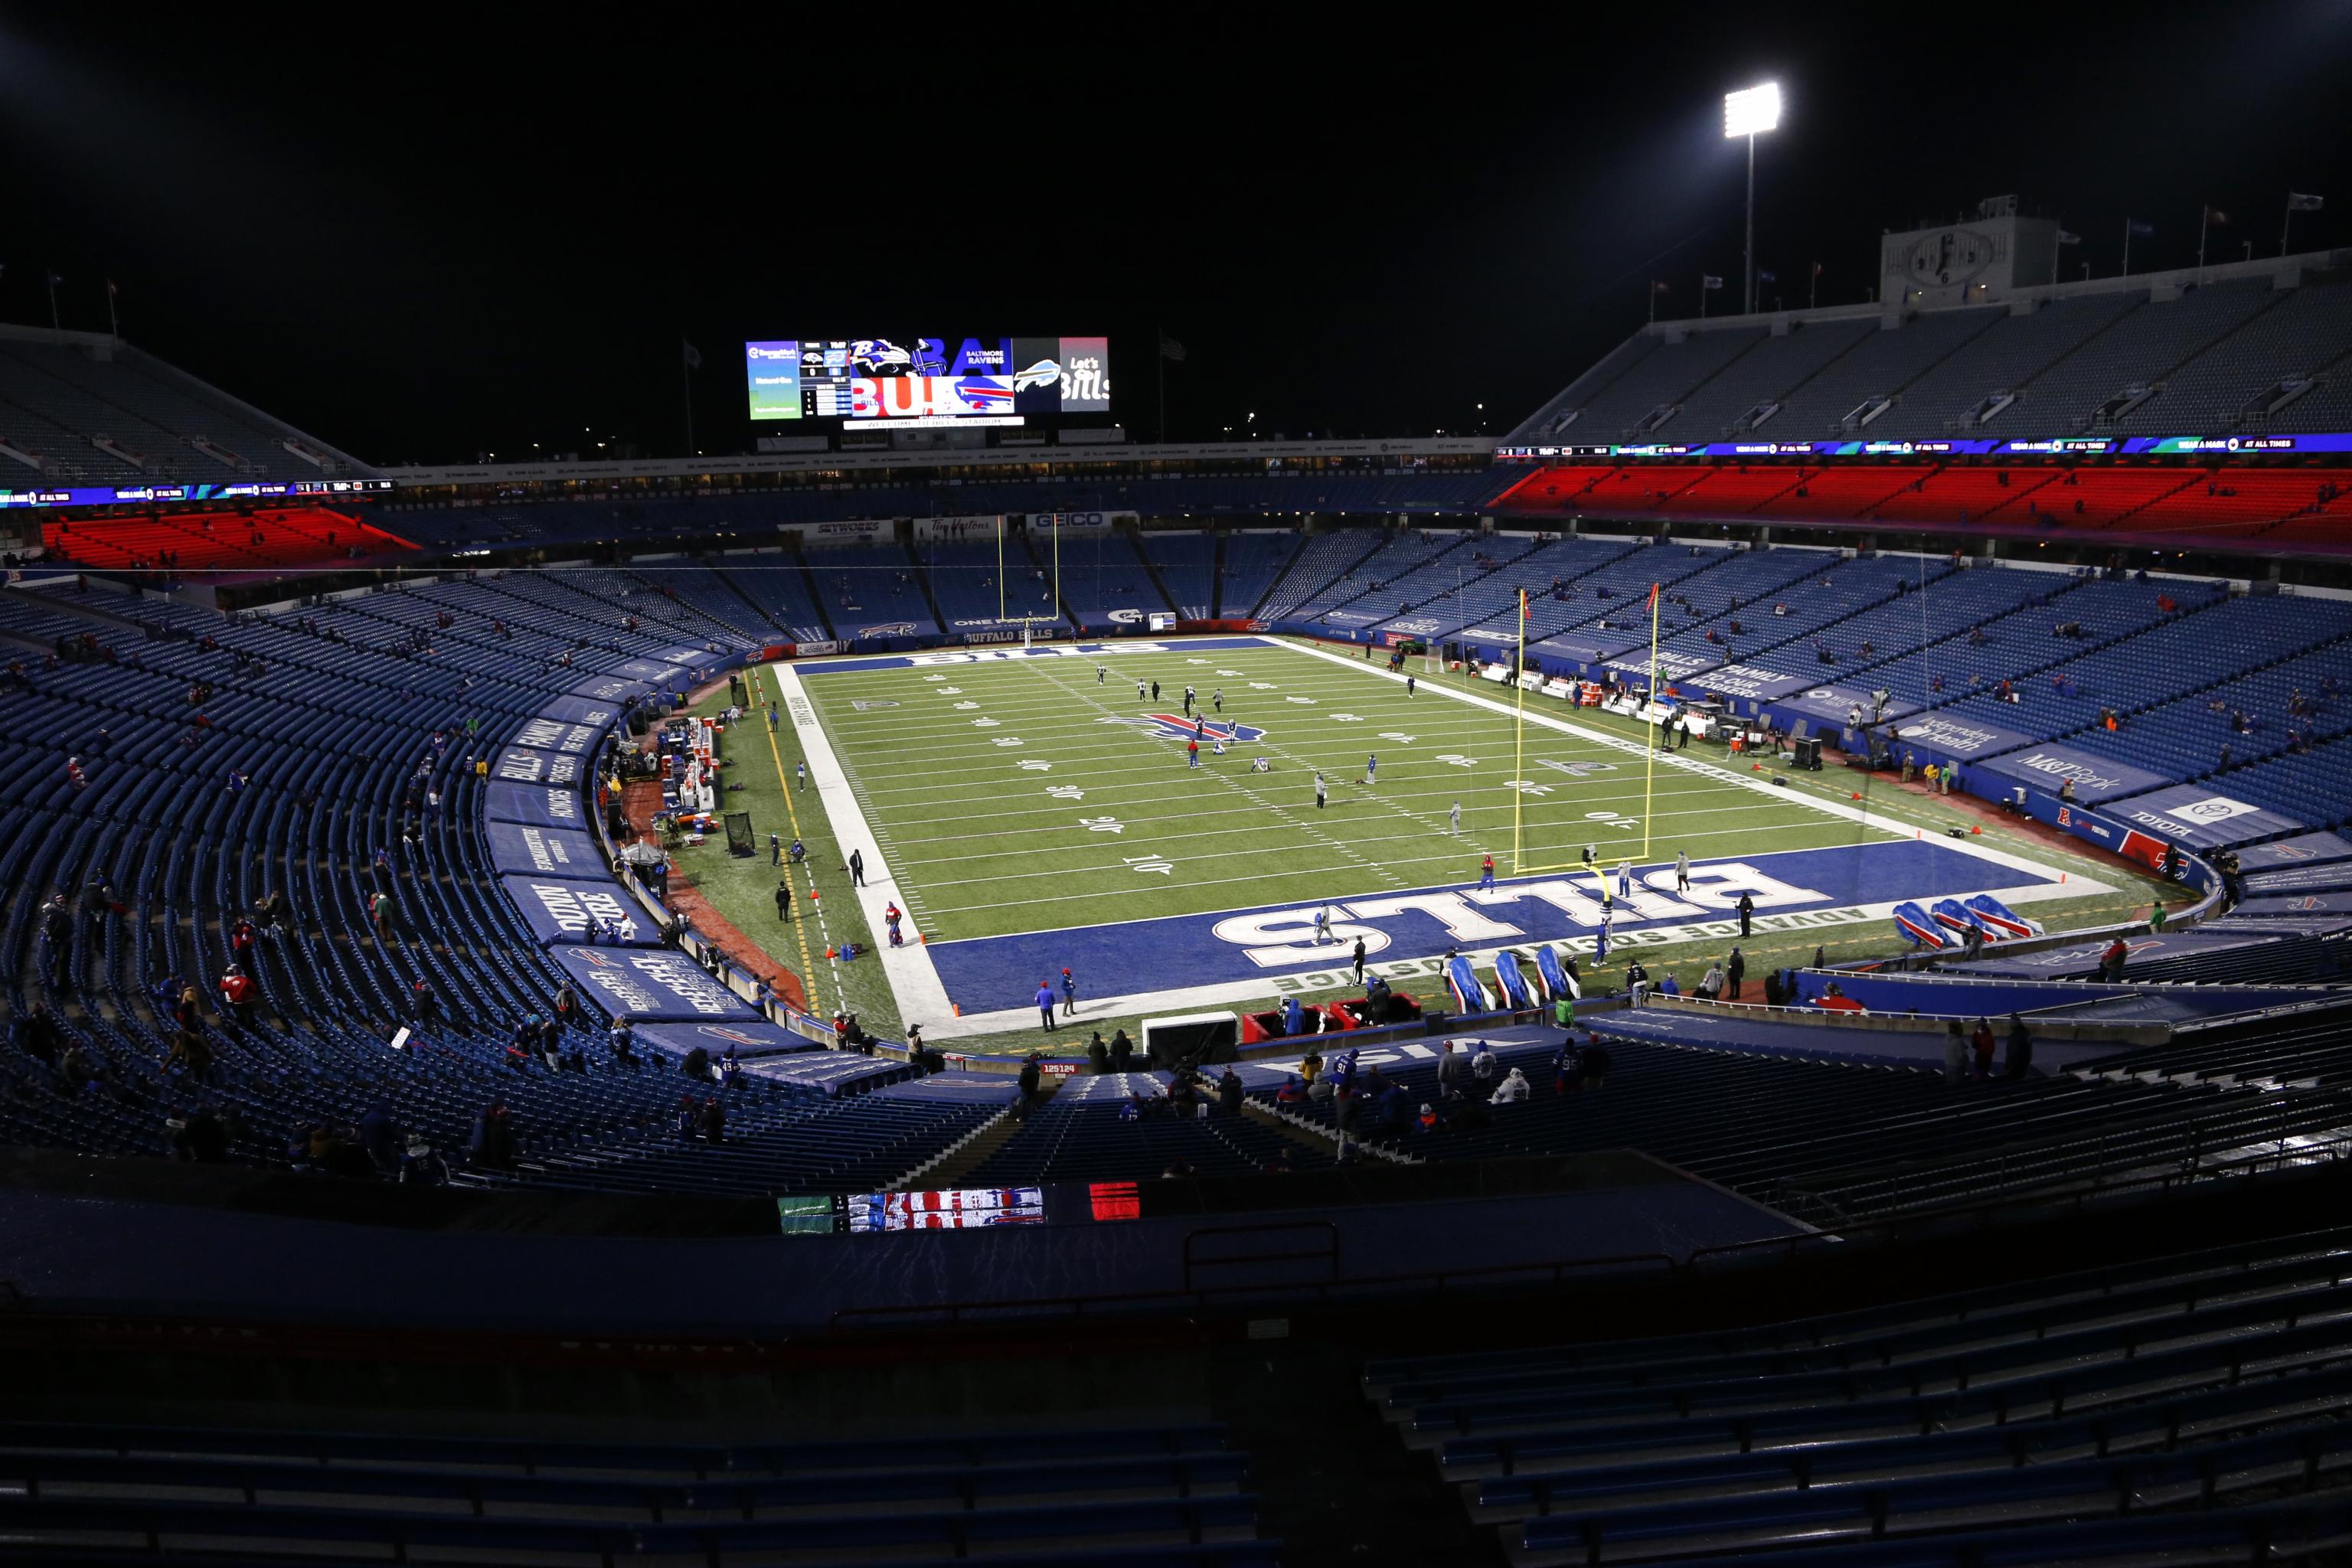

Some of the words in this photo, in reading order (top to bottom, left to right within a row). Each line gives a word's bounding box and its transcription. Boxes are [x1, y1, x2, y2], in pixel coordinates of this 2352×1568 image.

[1942, 273, 1949, 283] 6
[1070, 357, 1099, 369] Let's
[1060, 370, 1110, 400] Bills
[931, 519, 948, 531] Tim
[1036, 513, 1102, 527] GEICO
[1018, 629, 1054, 640] BLLS
[1390, 622, 1439, 632] SENECA
[1462, 629, 1521, 642] GEICO
[906, 642, 1170, 666] BILLS
[1655, 652, 1707, 665] BILLS
[1724, 664, 1796, 684] FAMILY
[1684, 678, 1762, 698] WORKERS
[1700, 671, 1724, 681] TO
[1727, 677, 1762, 688] OUR
[582, 711, 609, 725] LINES
[517, 718, 566, 748] FAMILY
[567, 725, 594, 743] FRONT
[1918, 717, 1997, 742] Independent
[991, 737, 1024, 746] 50
[1920, 730, 1981, 752] Health
[499, 754, 543, 781] BILLS
[1016, 760, 1052, 771] 40
[1435, 755, 1478, 765] 30
[548, 764, 574, 782] THOSE
[2069, 769, 2119, 790] Bank
[1046, 785, 1084, 798] 30
[1504, 780, 1555, 794] 20
[547, 789, 574, 818] HONORS
[1078, 816, 1124, 831] 20
[1585, 812, 1640, 827] 10
[2130, 811, 2194, 837] TOYOTA
[1122, 854, 1173, 873] 10
[531, 884, 589, 931] DUNN
[1211, 862, 1834, 968] BILLS
[1682, 908, 1869, 939] ADVANCE
[1252, 1039, 1542, 1075] VISA
[1338, 1063, 1348, 1074] 91
